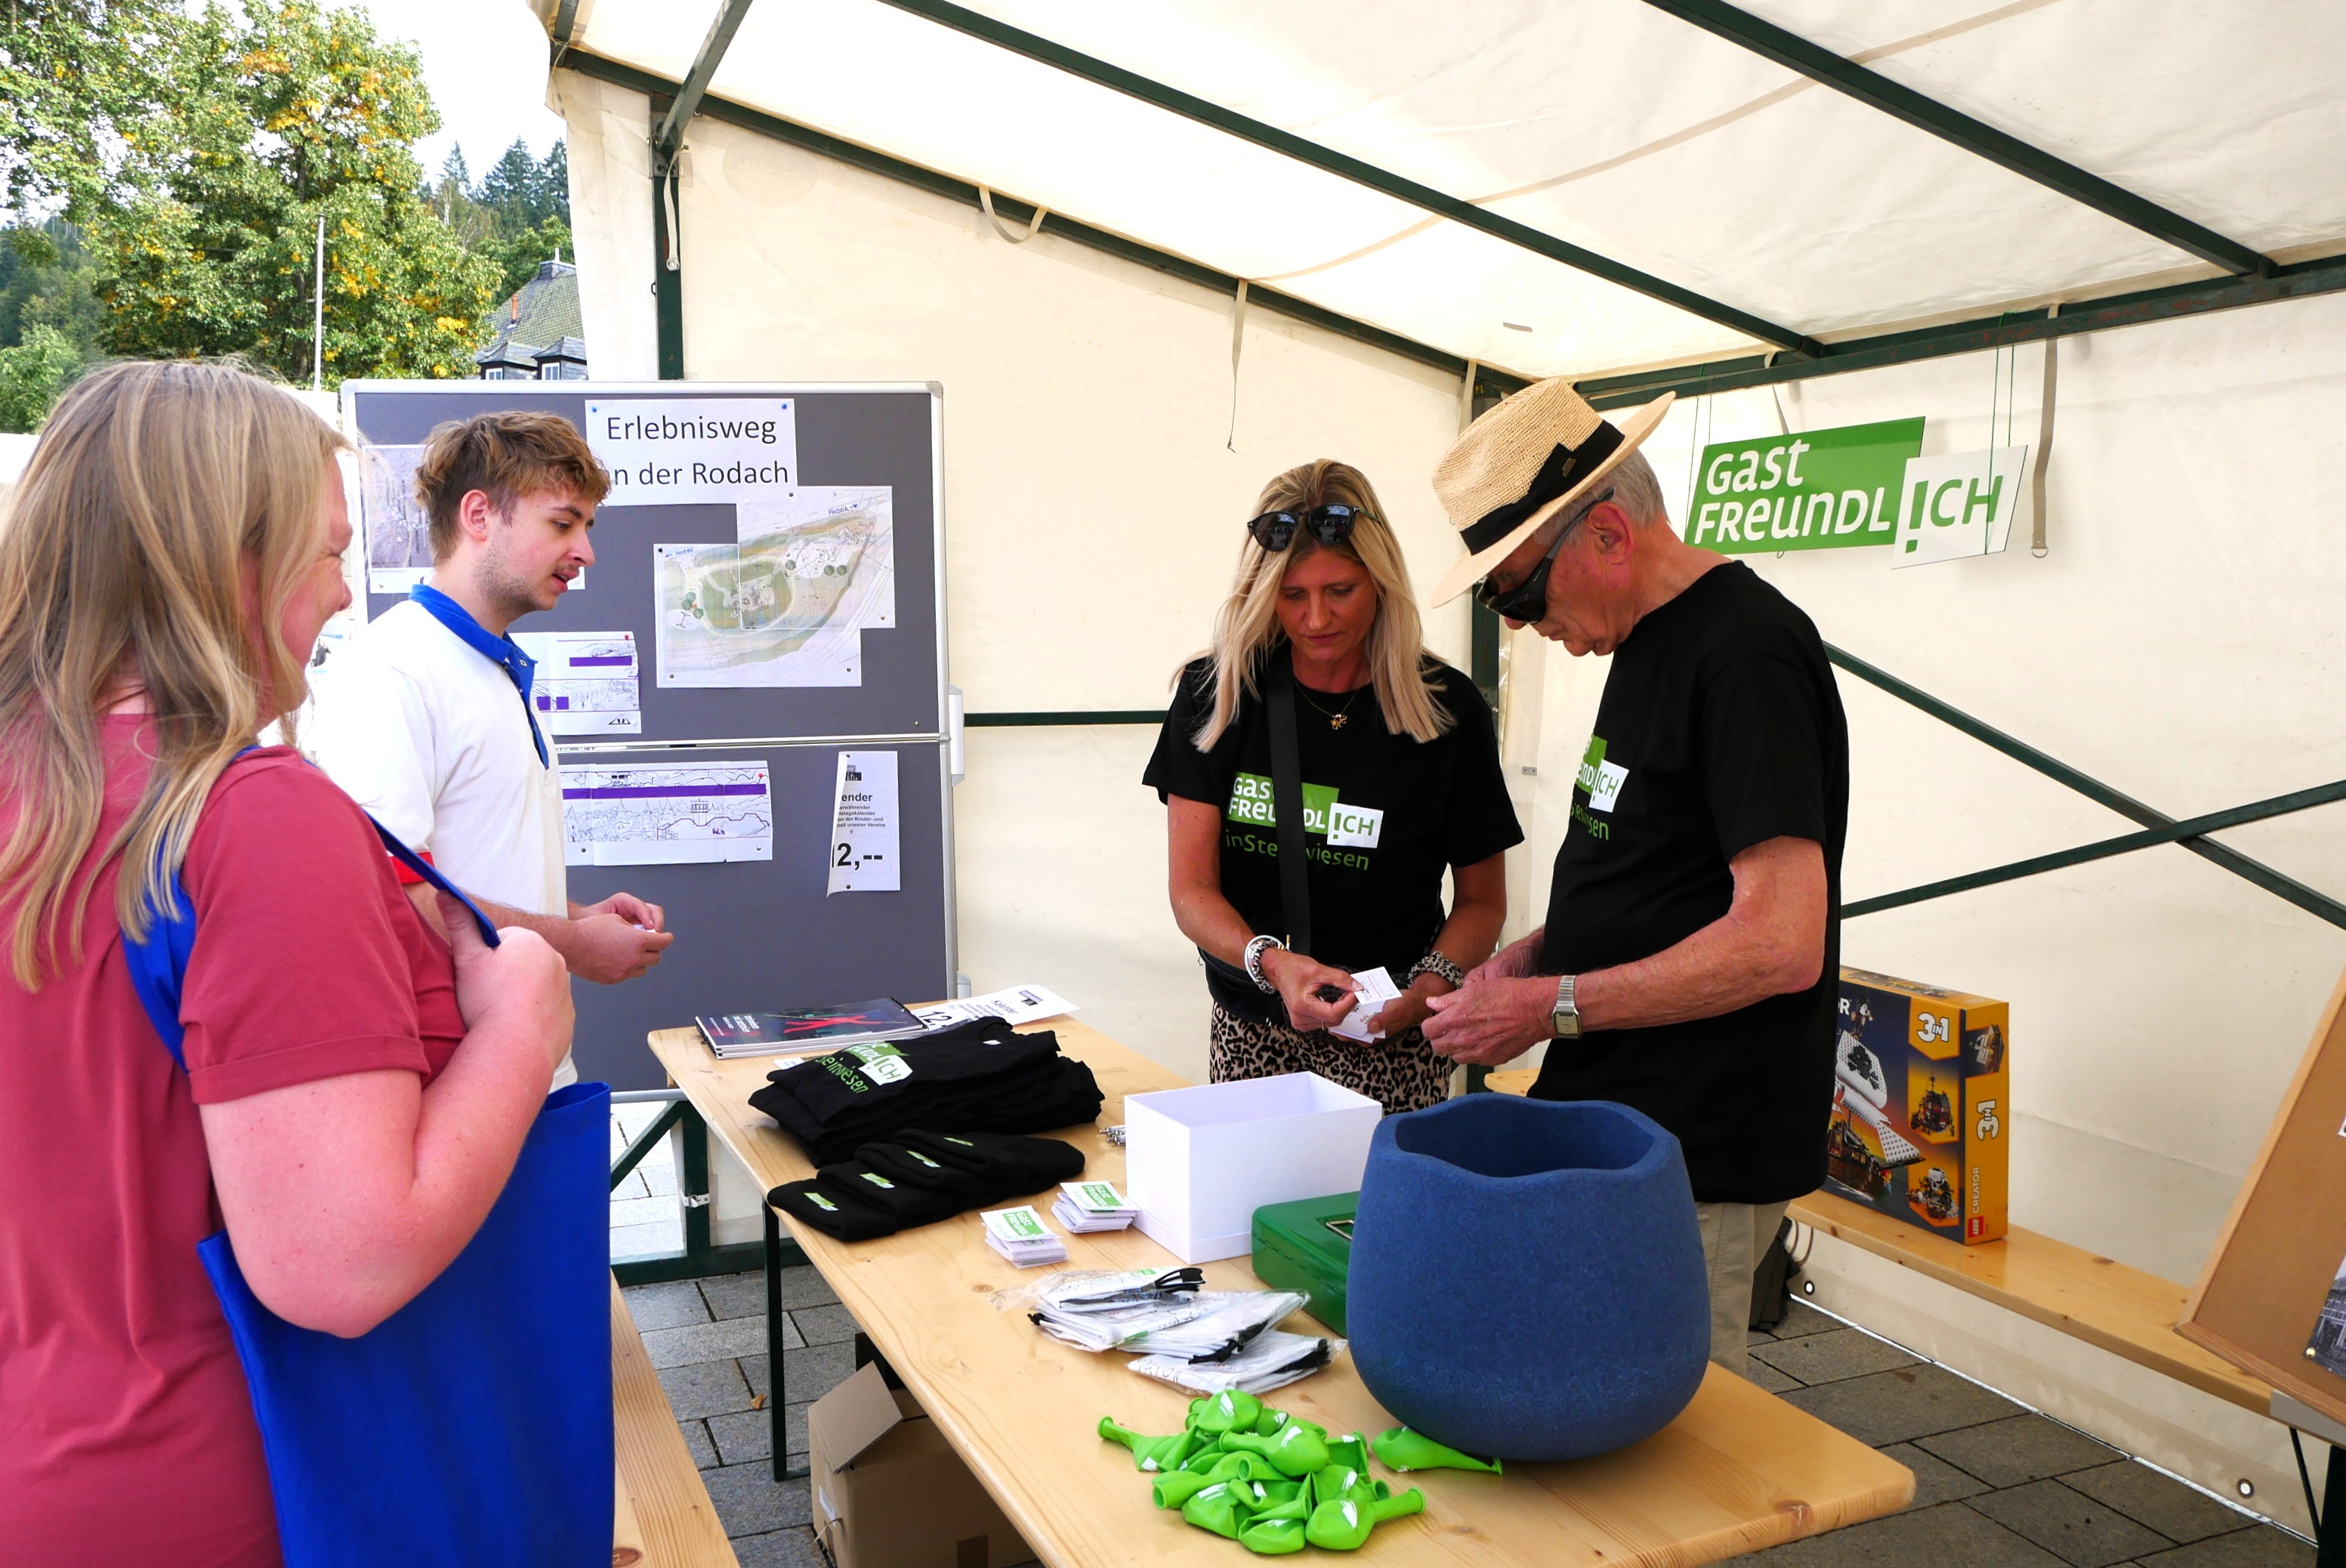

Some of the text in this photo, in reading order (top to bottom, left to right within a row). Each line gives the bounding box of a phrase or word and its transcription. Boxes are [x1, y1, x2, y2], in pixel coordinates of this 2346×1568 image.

[607, 415, 776, 444] Erlebnisweg
[614, 461, 789, 486] n der Rodach
[1706, 439, 1810, 495] Gast
[841, 792, 872, 802] ender
[1233, 776, 1274, 800] Gas
[1972, 1166, 1980, 1214] CREATOR
